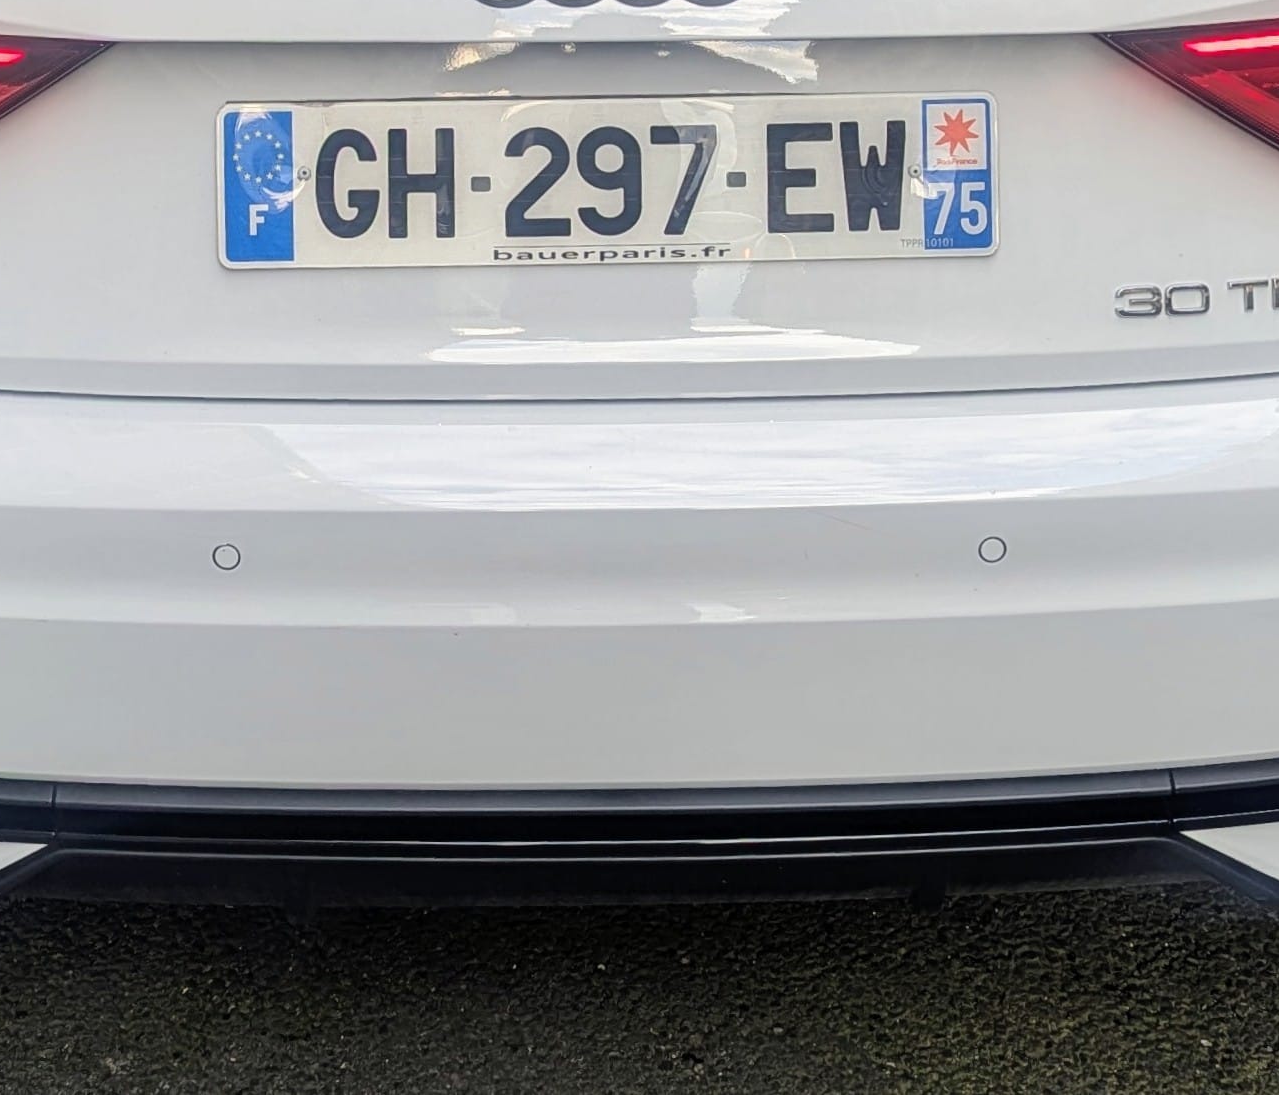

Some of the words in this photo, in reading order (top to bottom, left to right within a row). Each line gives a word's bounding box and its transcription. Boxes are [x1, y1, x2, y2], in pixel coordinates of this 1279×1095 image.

[315, 119, 906, 239] GH-297-EW
[248, 203, 269, 236] F
[927, 181, 988, 235] 75
[493, 246, 732, 262] bauerparis.fr
[1114, 281, 1211, 318] 30
